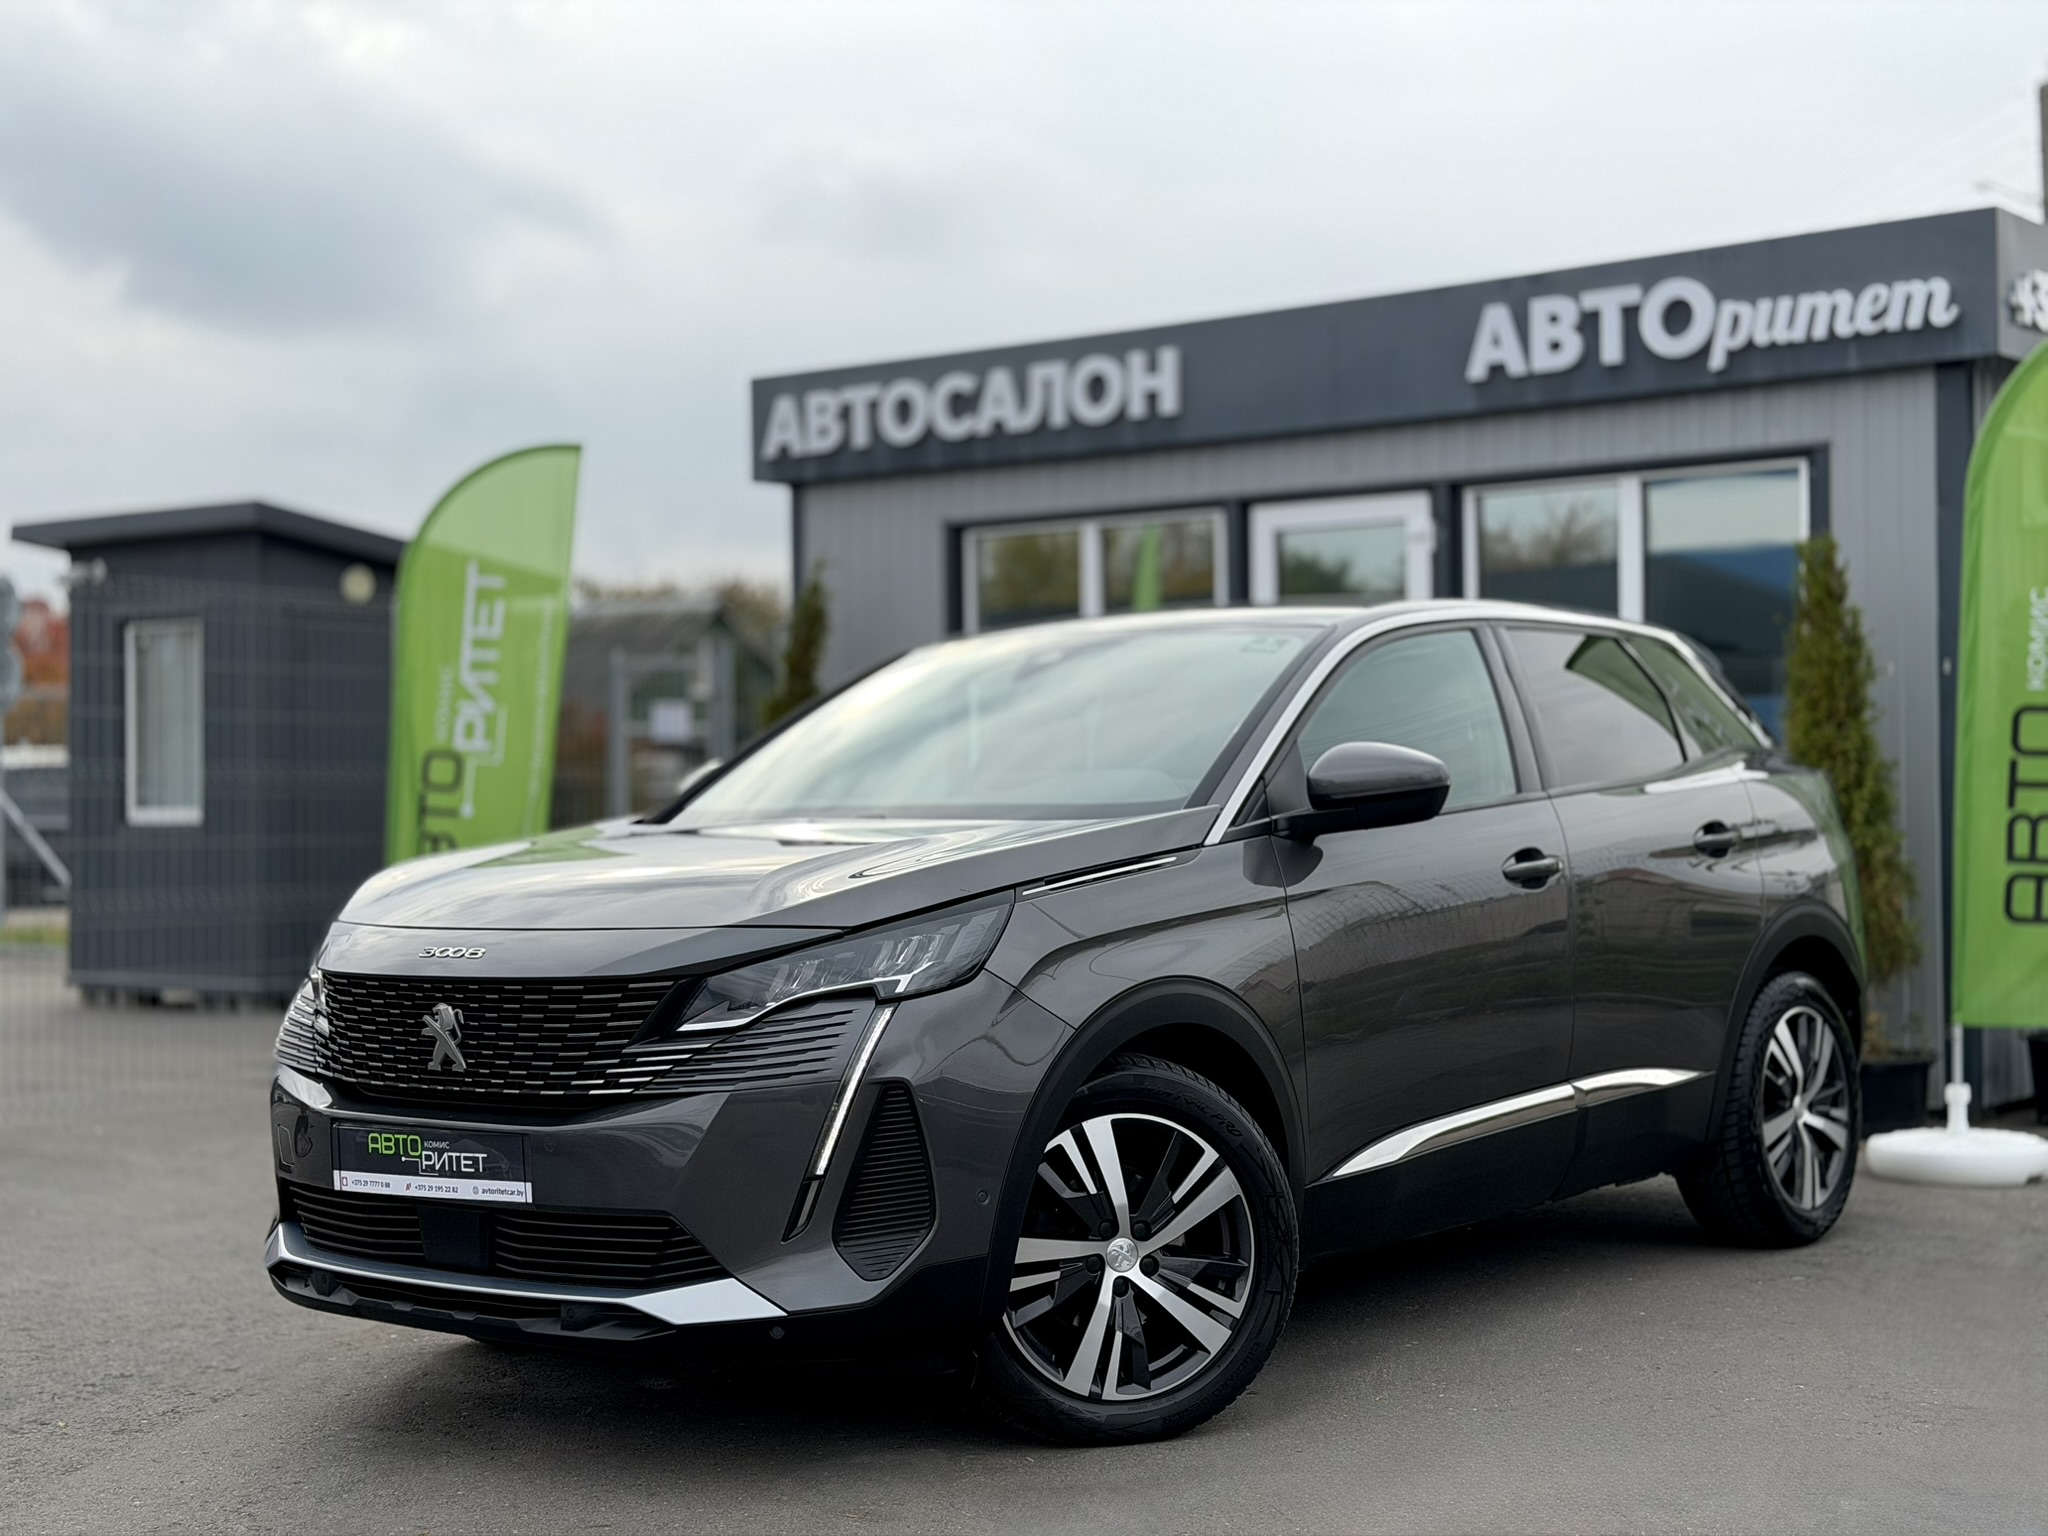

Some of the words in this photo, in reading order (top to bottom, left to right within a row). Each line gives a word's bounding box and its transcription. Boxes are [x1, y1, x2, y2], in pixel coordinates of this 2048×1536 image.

[1464, 276, 1961, 383] АВТОритет
[760, 345, 1183, 461] АВТОСАЛОН
[452, 558, 507, 754] РИТЕТ
[418, 946, 487, 959] 3008
[368, 1133, 421, 1156] АВТО
[424, 1140, 450, 1149] КОМИС
[422, 1151, 488, 1173] РИТЕТ
[481, 1187, 524, 1198] avtoritetcar.by
